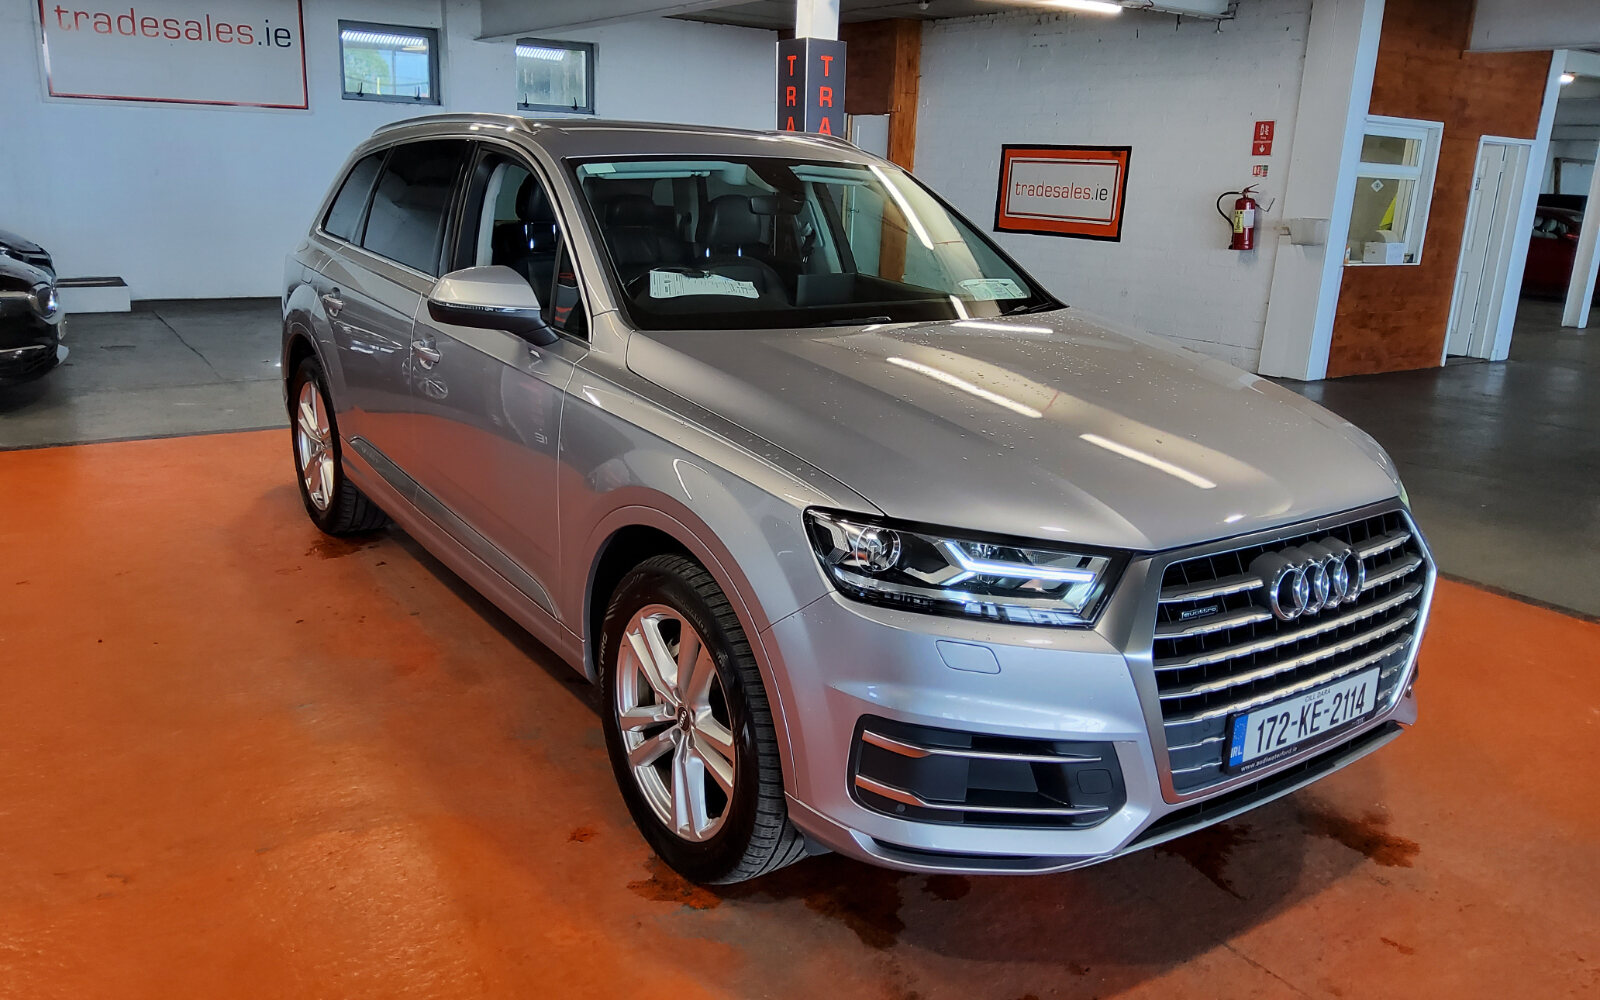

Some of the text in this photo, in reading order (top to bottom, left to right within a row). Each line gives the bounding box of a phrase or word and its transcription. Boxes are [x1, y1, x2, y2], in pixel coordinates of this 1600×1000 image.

[54, 4, 292, 48] tradesales.ie
[1015, 180, 1108, 202] tradesales.ie
[1257, 682, 1367, 753] 172-KE-2114
[1230, 745, 1243, 759] IRL
